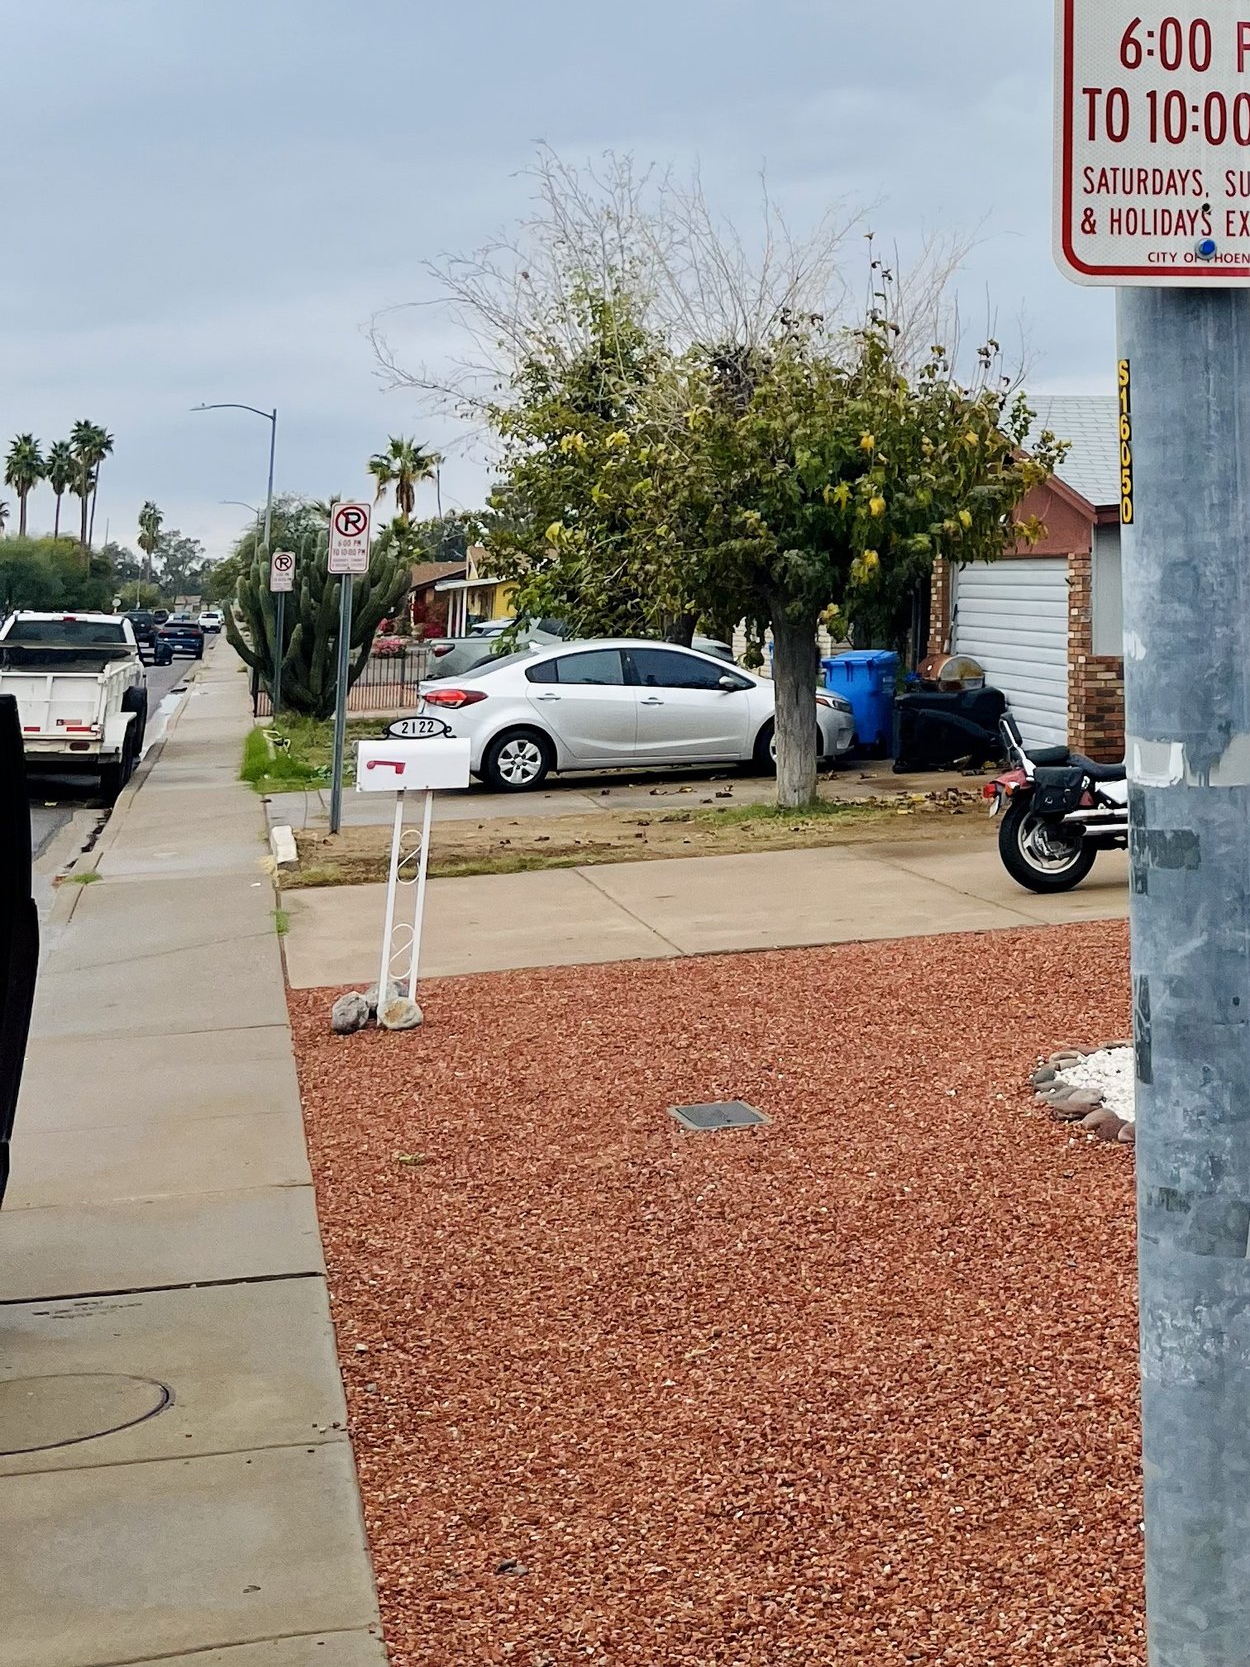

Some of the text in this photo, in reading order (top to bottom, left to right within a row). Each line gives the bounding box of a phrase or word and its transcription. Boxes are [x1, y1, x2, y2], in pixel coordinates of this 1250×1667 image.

[1120, 17, 1212, 73] 6:00
[1082, 87, 1130, 143] TO
[1083, 166, 1209, 198] SATURDAYS,
[1081, 207, 1097, 235] &
[1110, 207, 1212, 237] HOLIDAYS
[1147, 252, 1177, 263] CITY
[1118, 359, 1133, 524] S16050
[401, 720, 434, 734] 2122
